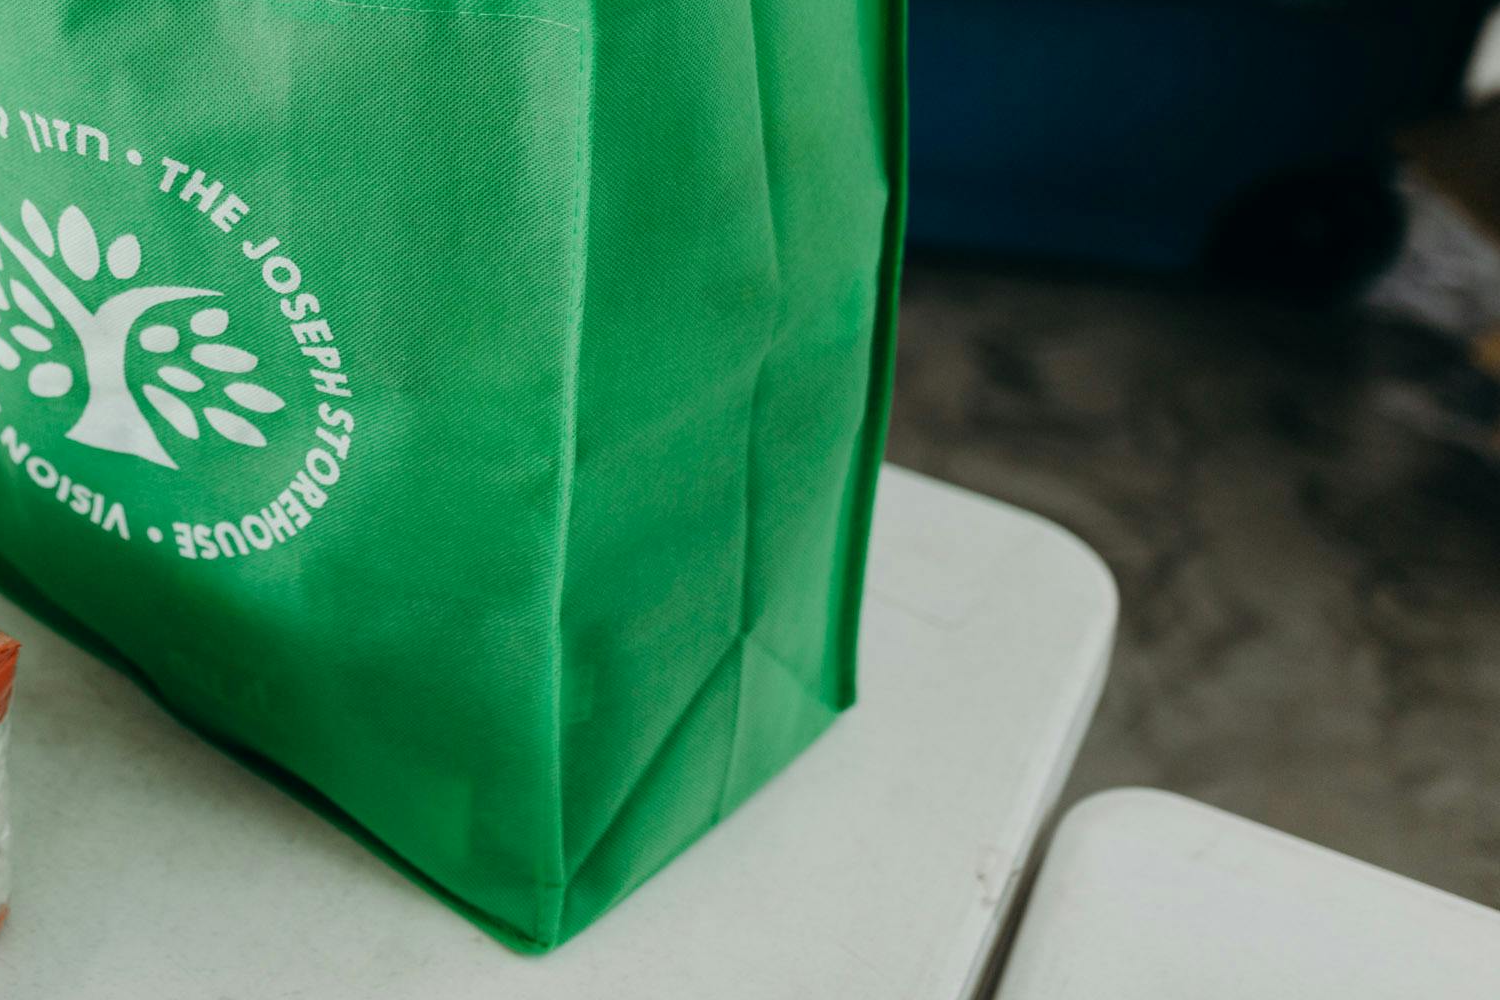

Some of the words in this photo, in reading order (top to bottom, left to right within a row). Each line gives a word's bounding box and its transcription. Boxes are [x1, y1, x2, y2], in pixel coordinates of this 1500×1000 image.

[19, 109, 110, 162] חזון
[159, 157, 250, 233] THE
[243, 237, 352, 397] JOSEPH
[0, 426, 129, 540] VISION
[173, 402, 354, 559] STOREHOUSE
